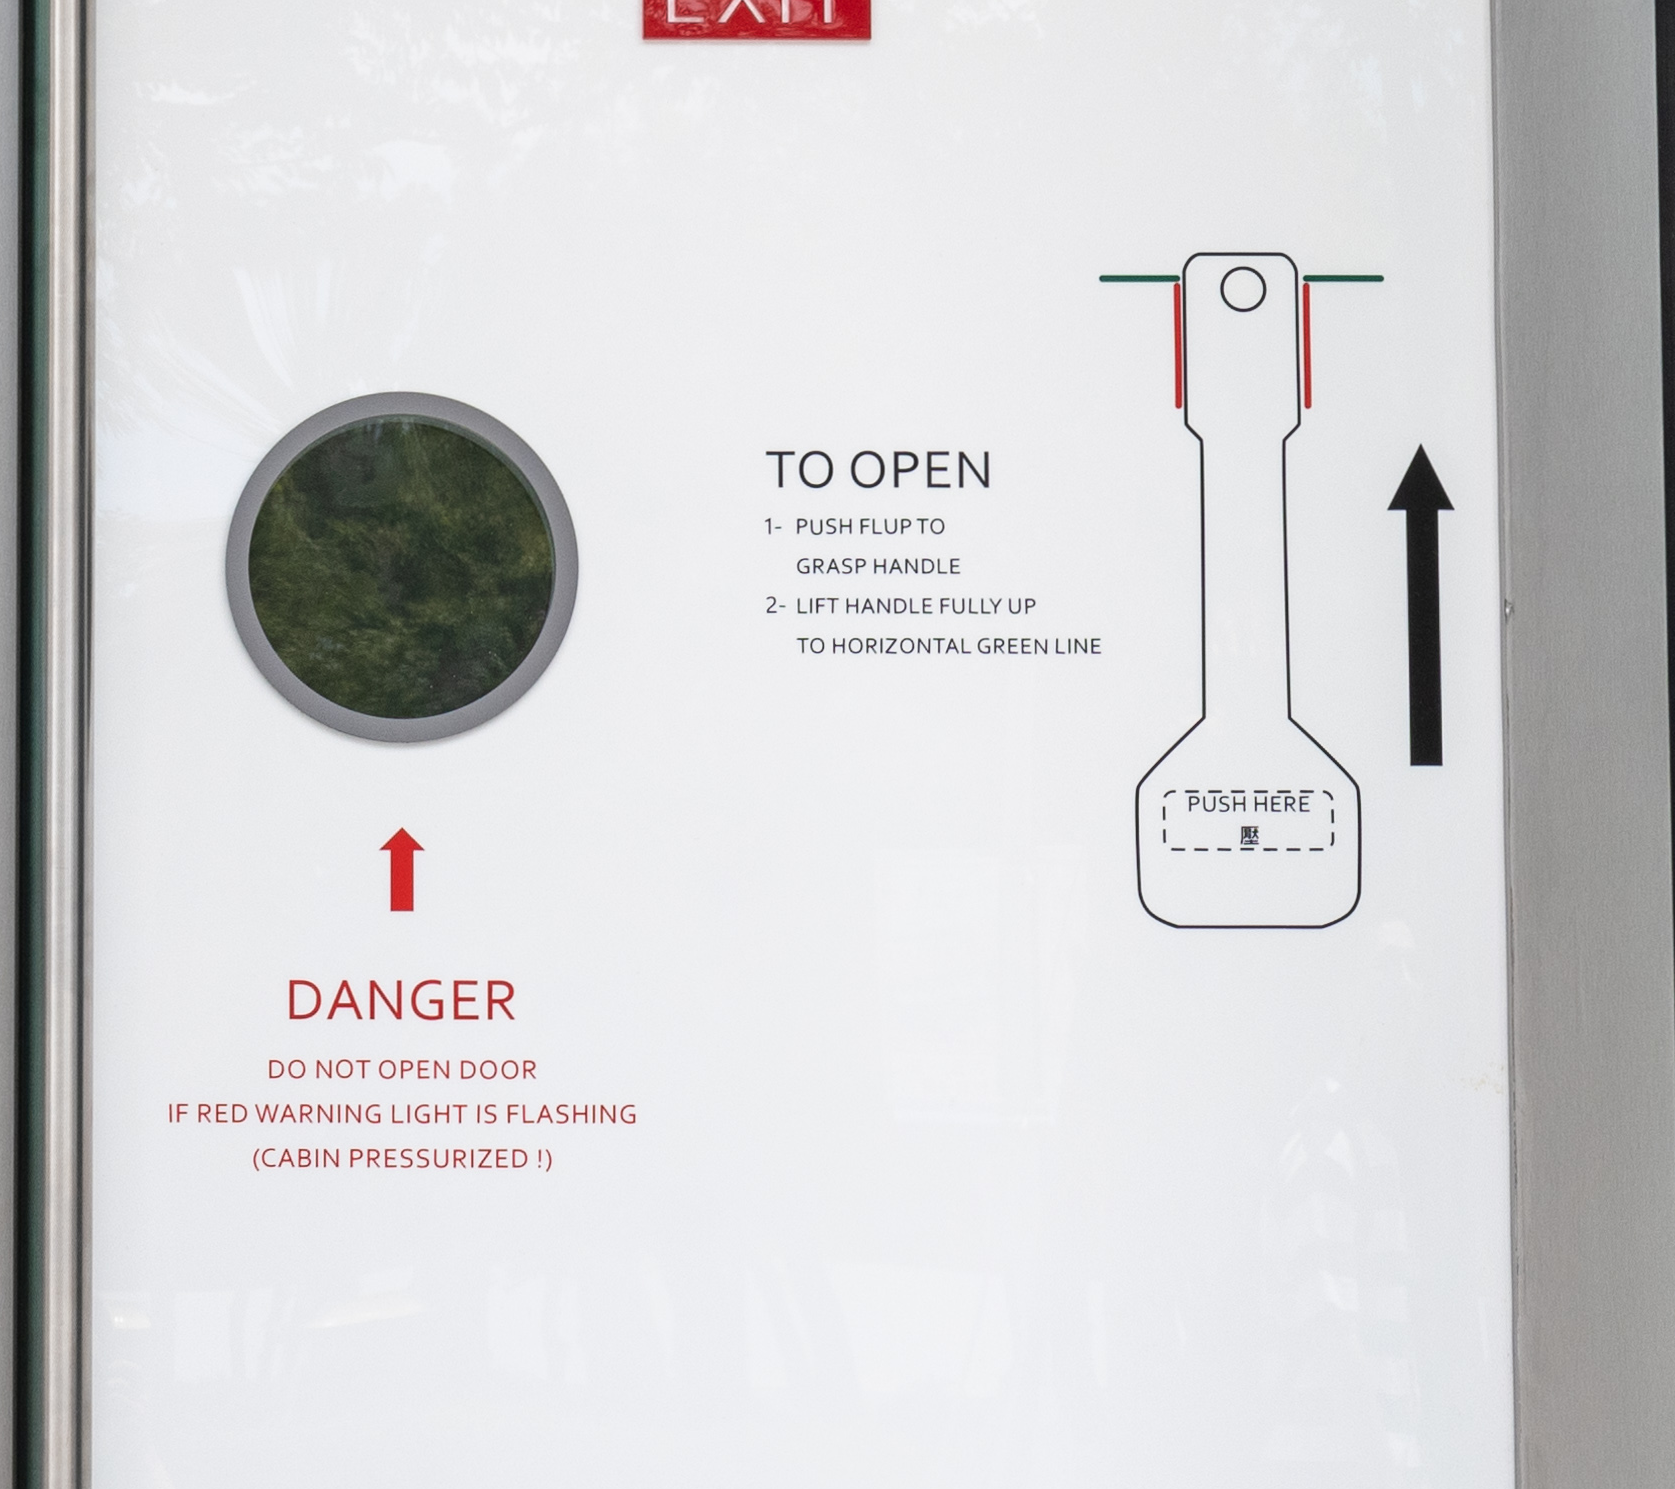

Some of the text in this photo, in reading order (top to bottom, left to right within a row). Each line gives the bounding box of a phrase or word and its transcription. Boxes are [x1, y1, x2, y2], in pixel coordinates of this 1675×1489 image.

[766, 450, 989, 489] TO OPEN
[797, 518, 852, 535] PUSH
[860, 518, 912, 534] FLUP
[916, 518, 945, 535] TO
[797, 558, 960, 574] GRASP HANDLE
[797, 598, 839, 614] LIFT
[846, 598, 933, 614] HANDLE
[940, 598, 1002, 614] FULLY
[1009, 598, 1036, 614] UP
[796, 638, 1101, 655] TO HORIZONTAL GREEN LINE
[1189, 796, 1310, 812] PUSH HERE
[1240, 826, 1259, 845] 壓
[289, 979, 515, 1021] DANGER
[269, 1059, 536, 1080] DO NOT OPEN DOOR
[169, 1104, 636, 1124] IF RED WARNING LIGHT IS FLASHING
[253, 1148, 339, 1171] (CABIN
[350, 1149, 528, 1168] PRESSURIZED
